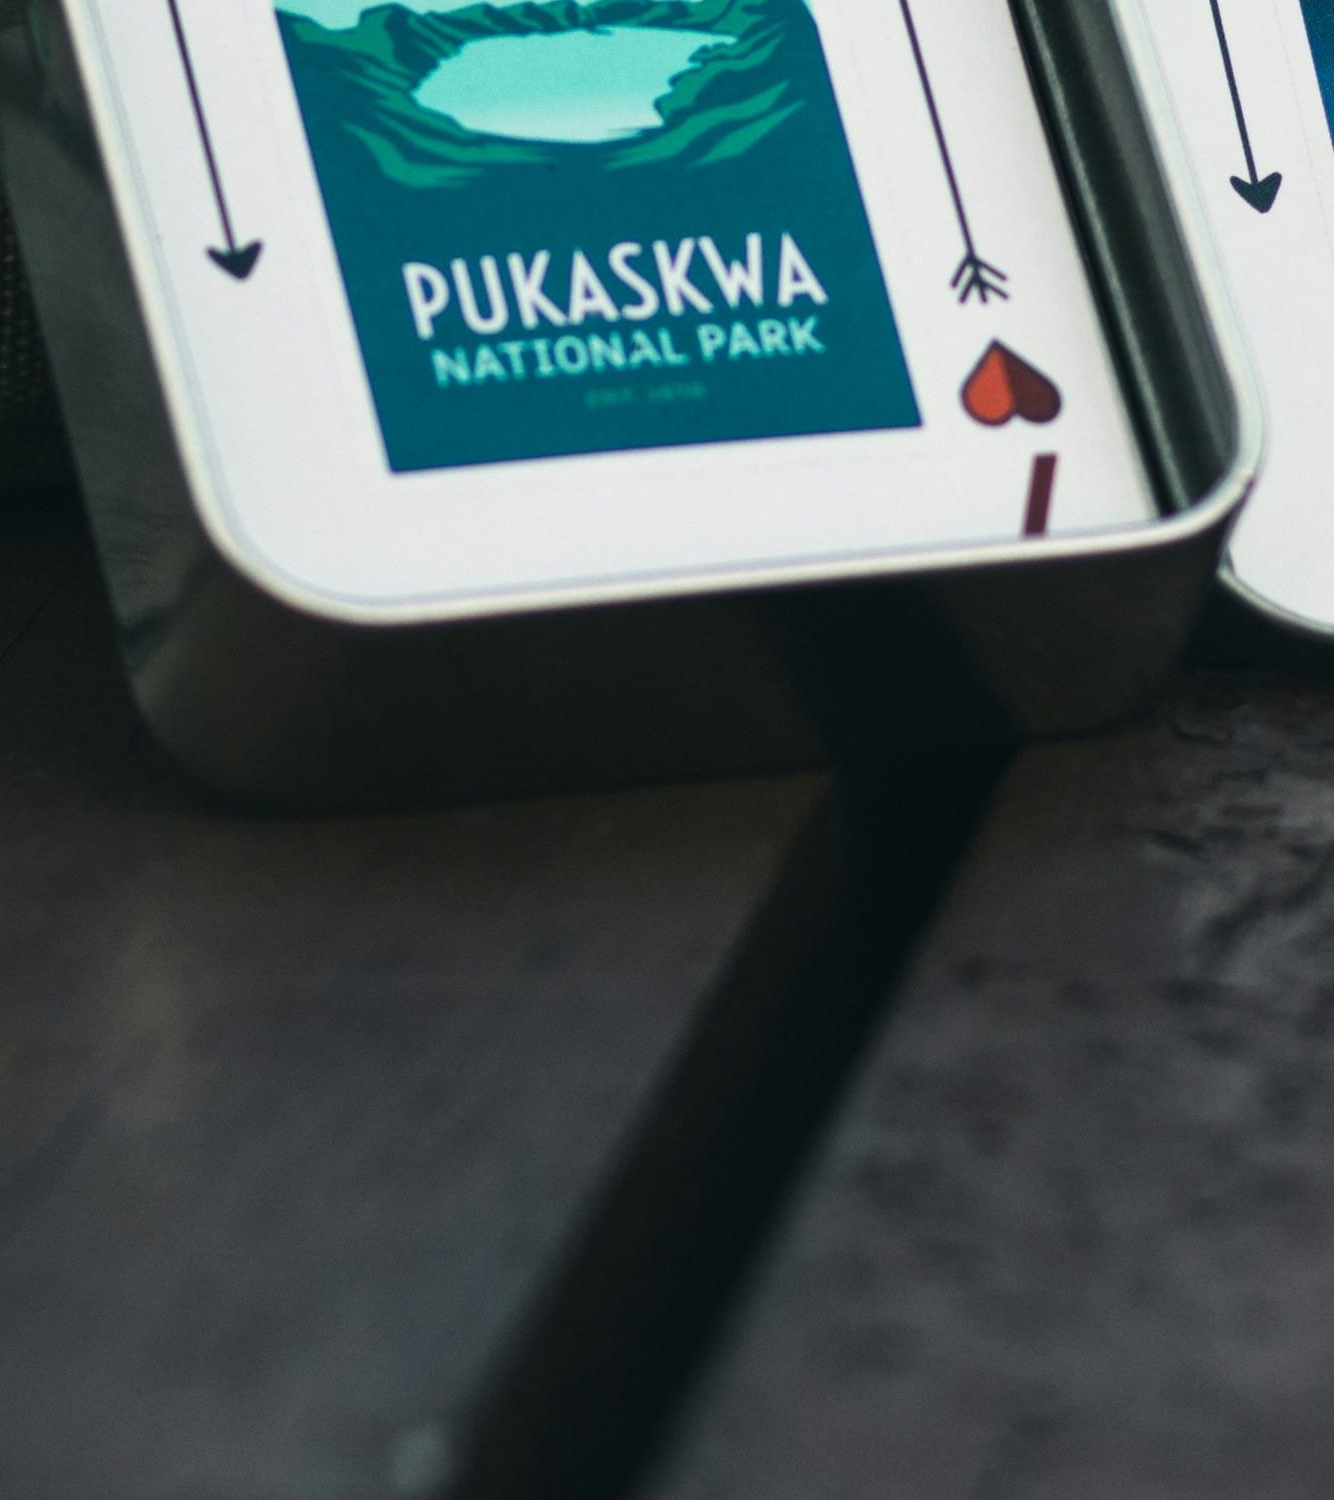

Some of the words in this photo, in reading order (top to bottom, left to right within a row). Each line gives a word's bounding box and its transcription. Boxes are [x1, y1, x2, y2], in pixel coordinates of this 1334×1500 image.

[402, 231, 829, 341] PUKASKWA
[430, 329, 688, 388] NATIONAL
[697, 316, 827, 363] PARK
